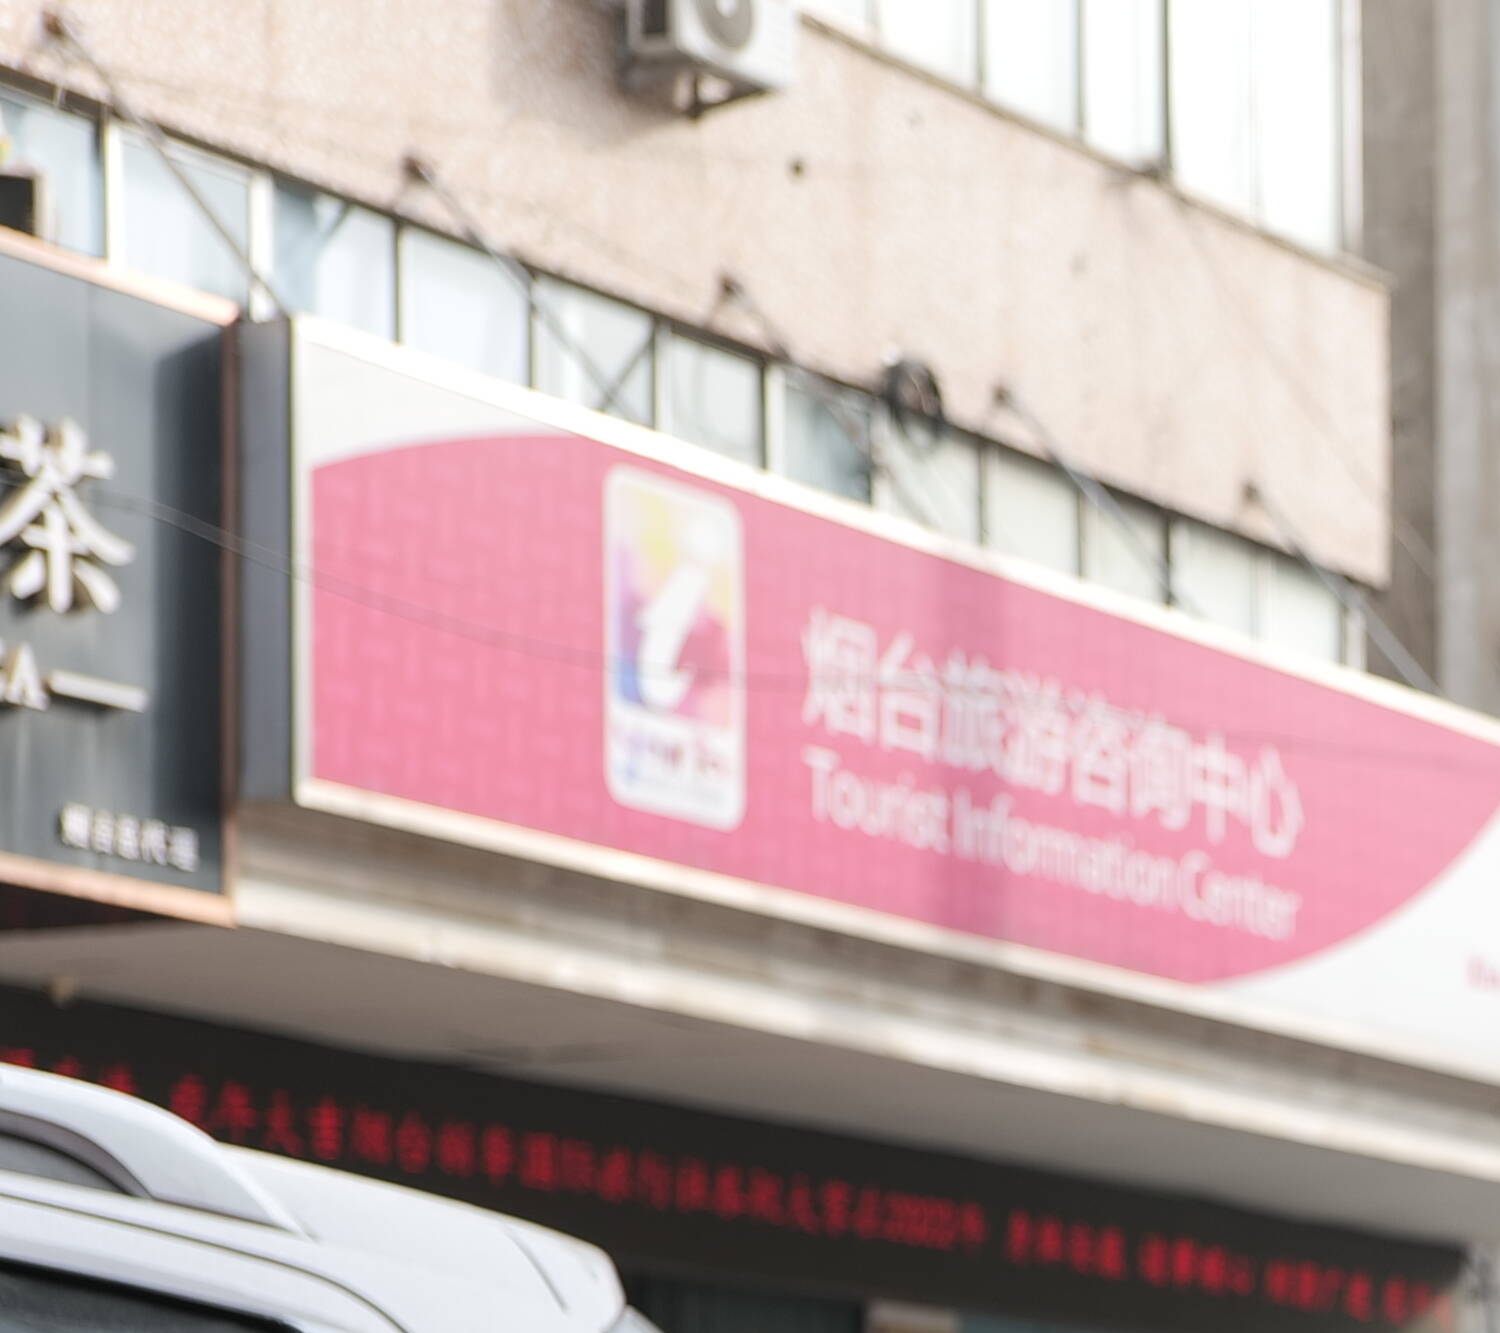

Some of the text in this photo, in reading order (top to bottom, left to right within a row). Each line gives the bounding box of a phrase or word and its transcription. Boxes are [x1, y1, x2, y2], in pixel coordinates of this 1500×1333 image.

[801, 604, 1305, 860] 烟台旅游咨询中心
[803, 744, 951, 856] Tourist
[951, 786, 1178, 911] Information
[1178, 848, 1304, 942] Center
